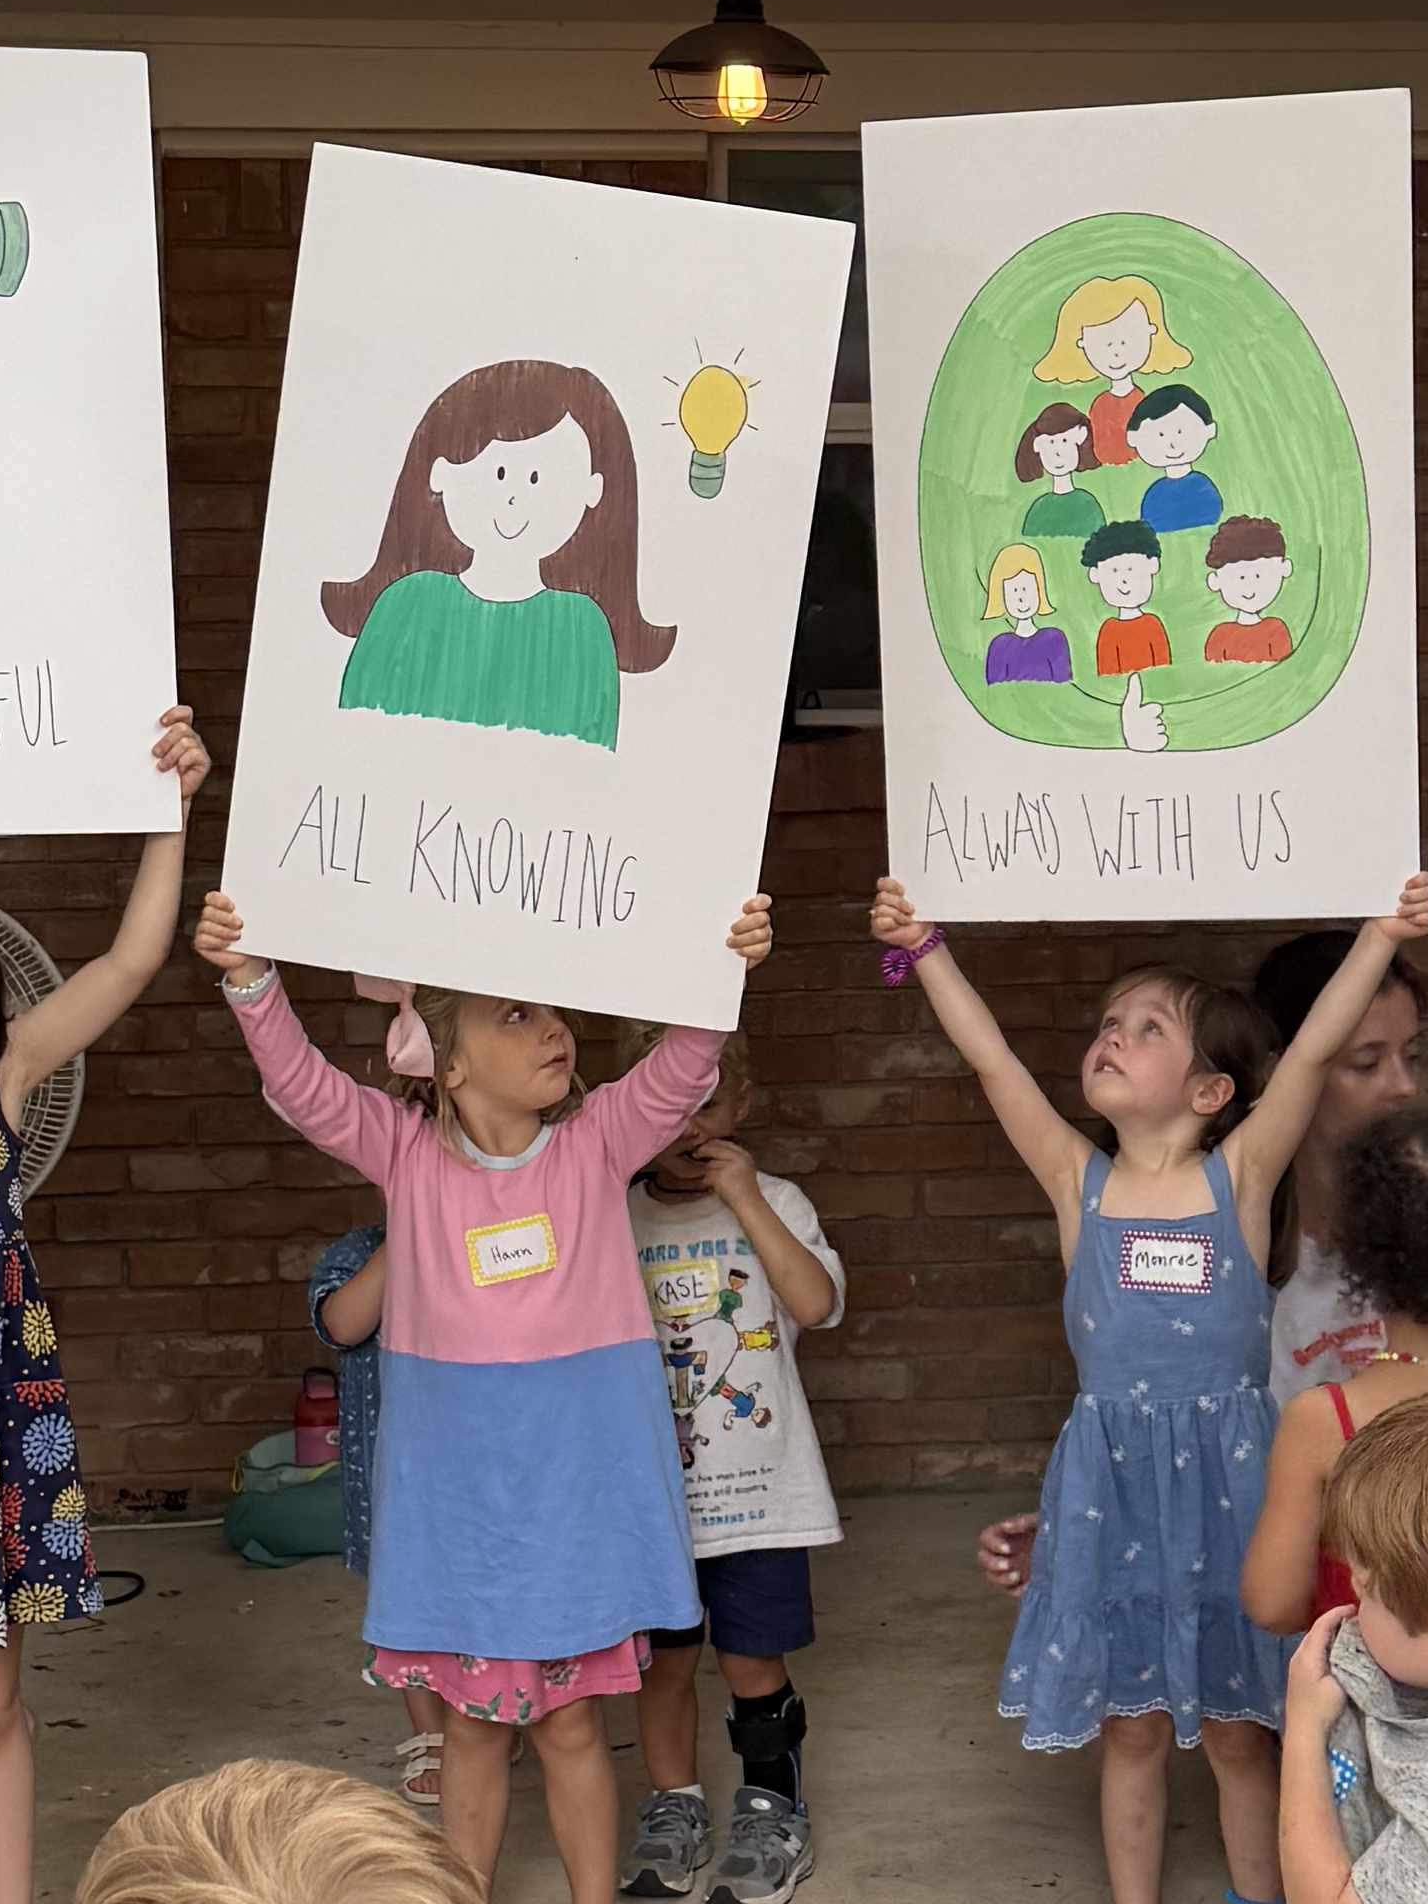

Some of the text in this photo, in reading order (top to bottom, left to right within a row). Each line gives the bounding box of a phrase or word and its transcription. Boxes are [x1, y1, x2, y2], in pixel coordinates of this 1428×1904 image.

[278, 785, 637, 929] ALL KNOWING
[924, 782, 1290, 882] ALWAYS WITH US
[653, 1271, 709, 1305] KASE
[1134, 1250, 1199, 1269] Monroe
